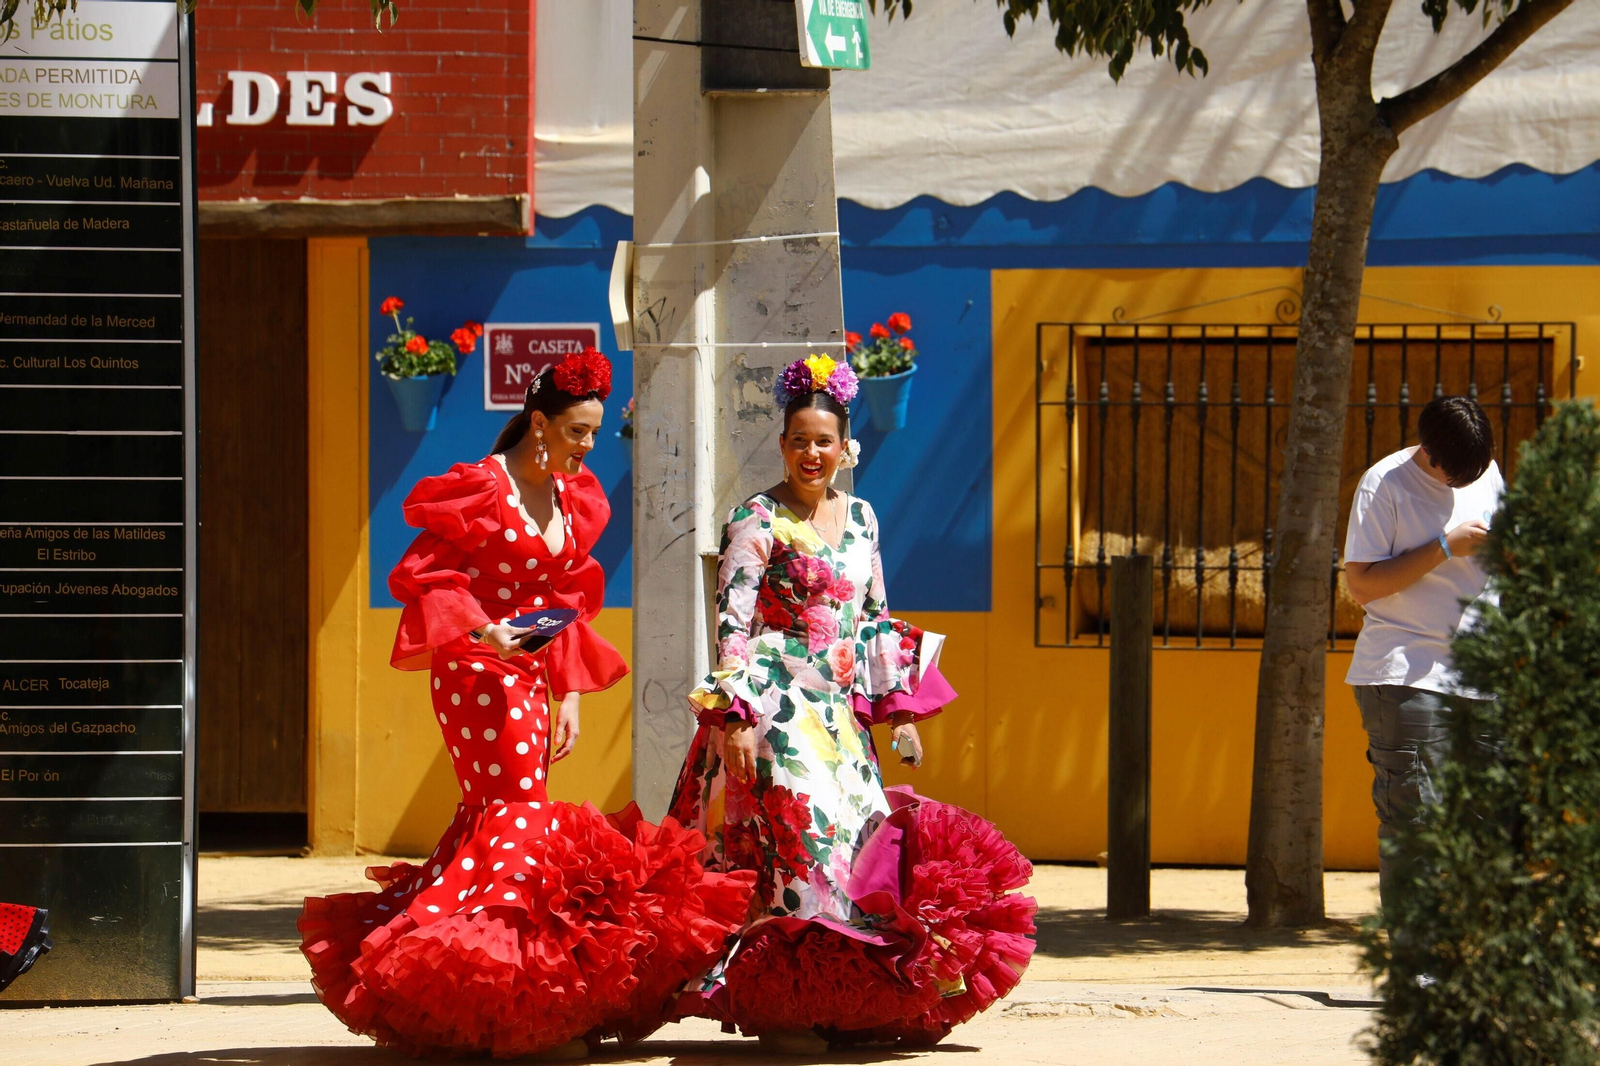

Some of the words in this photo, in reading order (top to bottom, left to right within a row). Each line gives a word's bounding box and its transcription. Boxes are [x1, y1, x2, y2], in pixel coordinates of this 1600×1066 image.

[31, 16, 114, 41] Patios
[35, 68, 143, 85] PERMITIDA
[27, 92, 52, 108] DE
[59, 93, 158, 110] MONTURA
[46, 174, 90, 188] Vuelva
[94, 176, 116, 188] Ud.
[120, 176, 174, 190] Mañana
[0, 218, 60, 231] astañuela
[63, 218, 79, 230] de
[82, 217, 130, 230] Madera
[71, 315, 87, 326] de
[91, 315, 103, 327] la
[106, 315, 156, 328] Merced
[528, 339, 584, 355] CASETA
[13, 356, 60, 369] Cultural
[63, 356, 86, 369] Los
[90, 356, 139, 370] Quintos
[24, 526, 70, 542] Amigos
[73, 527, 89, 540] de
[92, 527, 110, 540] las
[114, 527, 166, 540] Matildes
[37, 548, 50, 560] El
[53, 548, 97, 561] Estribo
[54, 582, 109, 595] Jóvenes
[111, 583, 179, 599] Abogados
[2, 679, 50, 691] ALCER
[58, 677, 110, 692] Tocateja
[49, 721, 68, 734] del
[71, 721, 137, 735] Gazpacho
[1, 769, 14, 782] El
